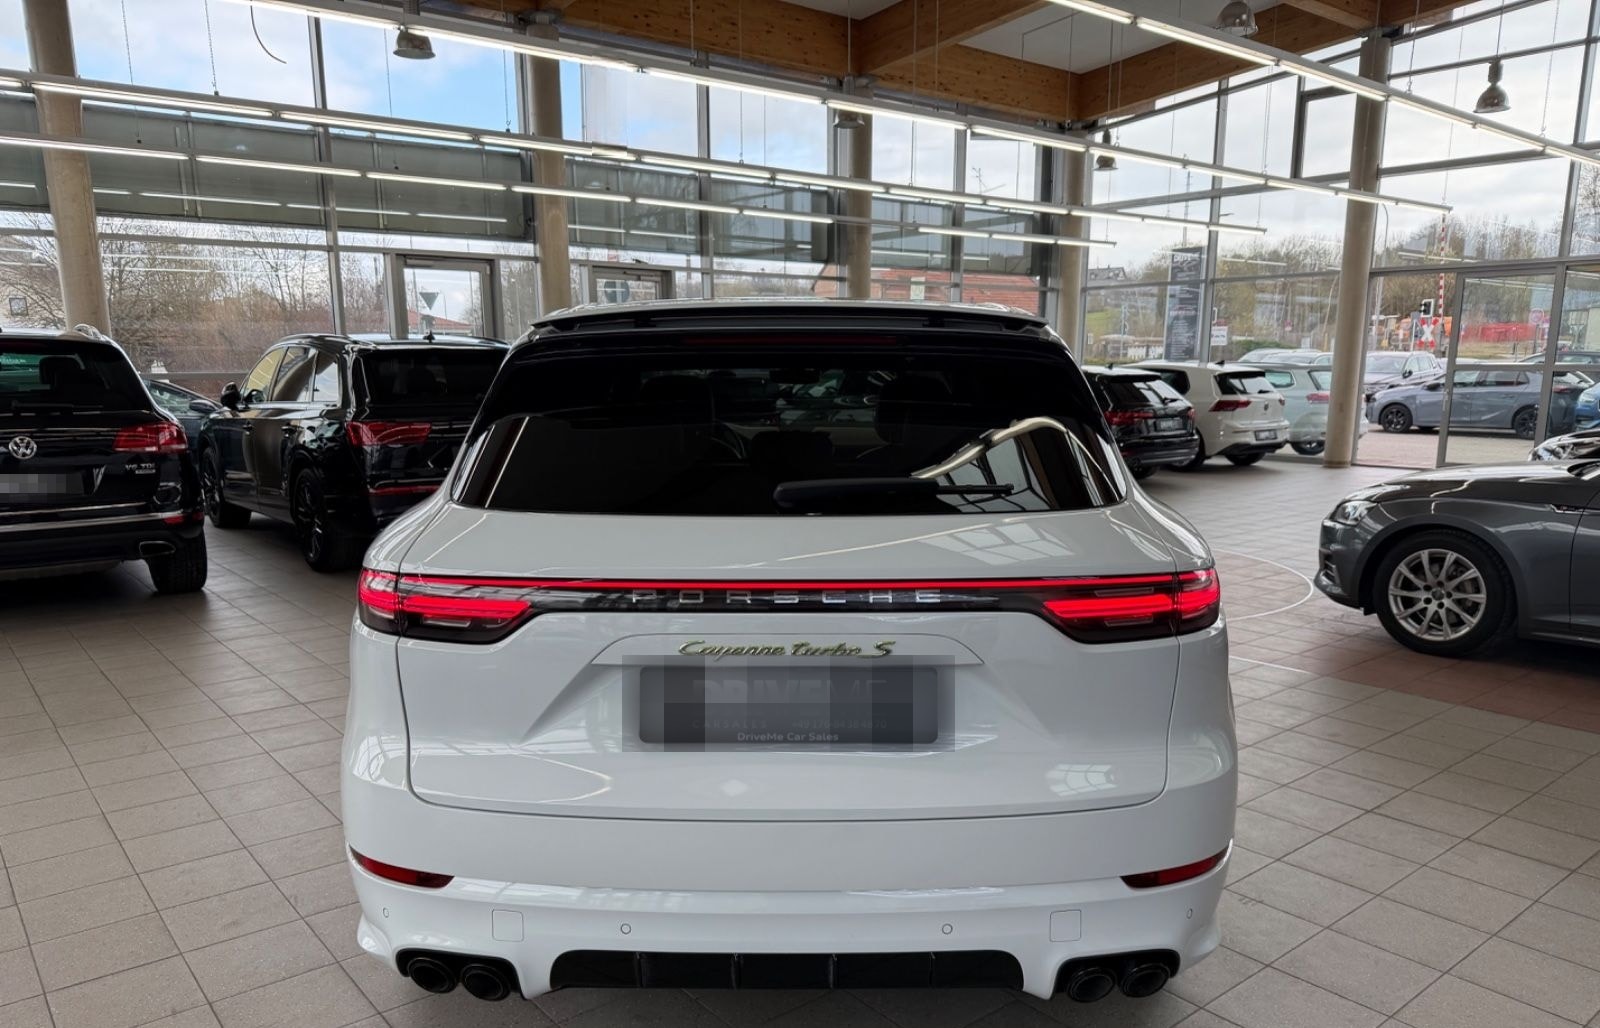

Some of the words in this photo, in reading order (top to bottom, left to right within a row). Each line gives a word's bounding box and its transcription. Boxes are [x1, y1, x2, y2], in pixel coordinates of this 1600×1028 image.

[632, 590, 941, 604] PORSCHE
[678, 640, 786, 662] Cayenne
[858, 640, 896, 659] S
[737, 731, 784, 742] DriveMe
[786, 731, 806, 742] Car
[808, 731, 839, 742] Sales
